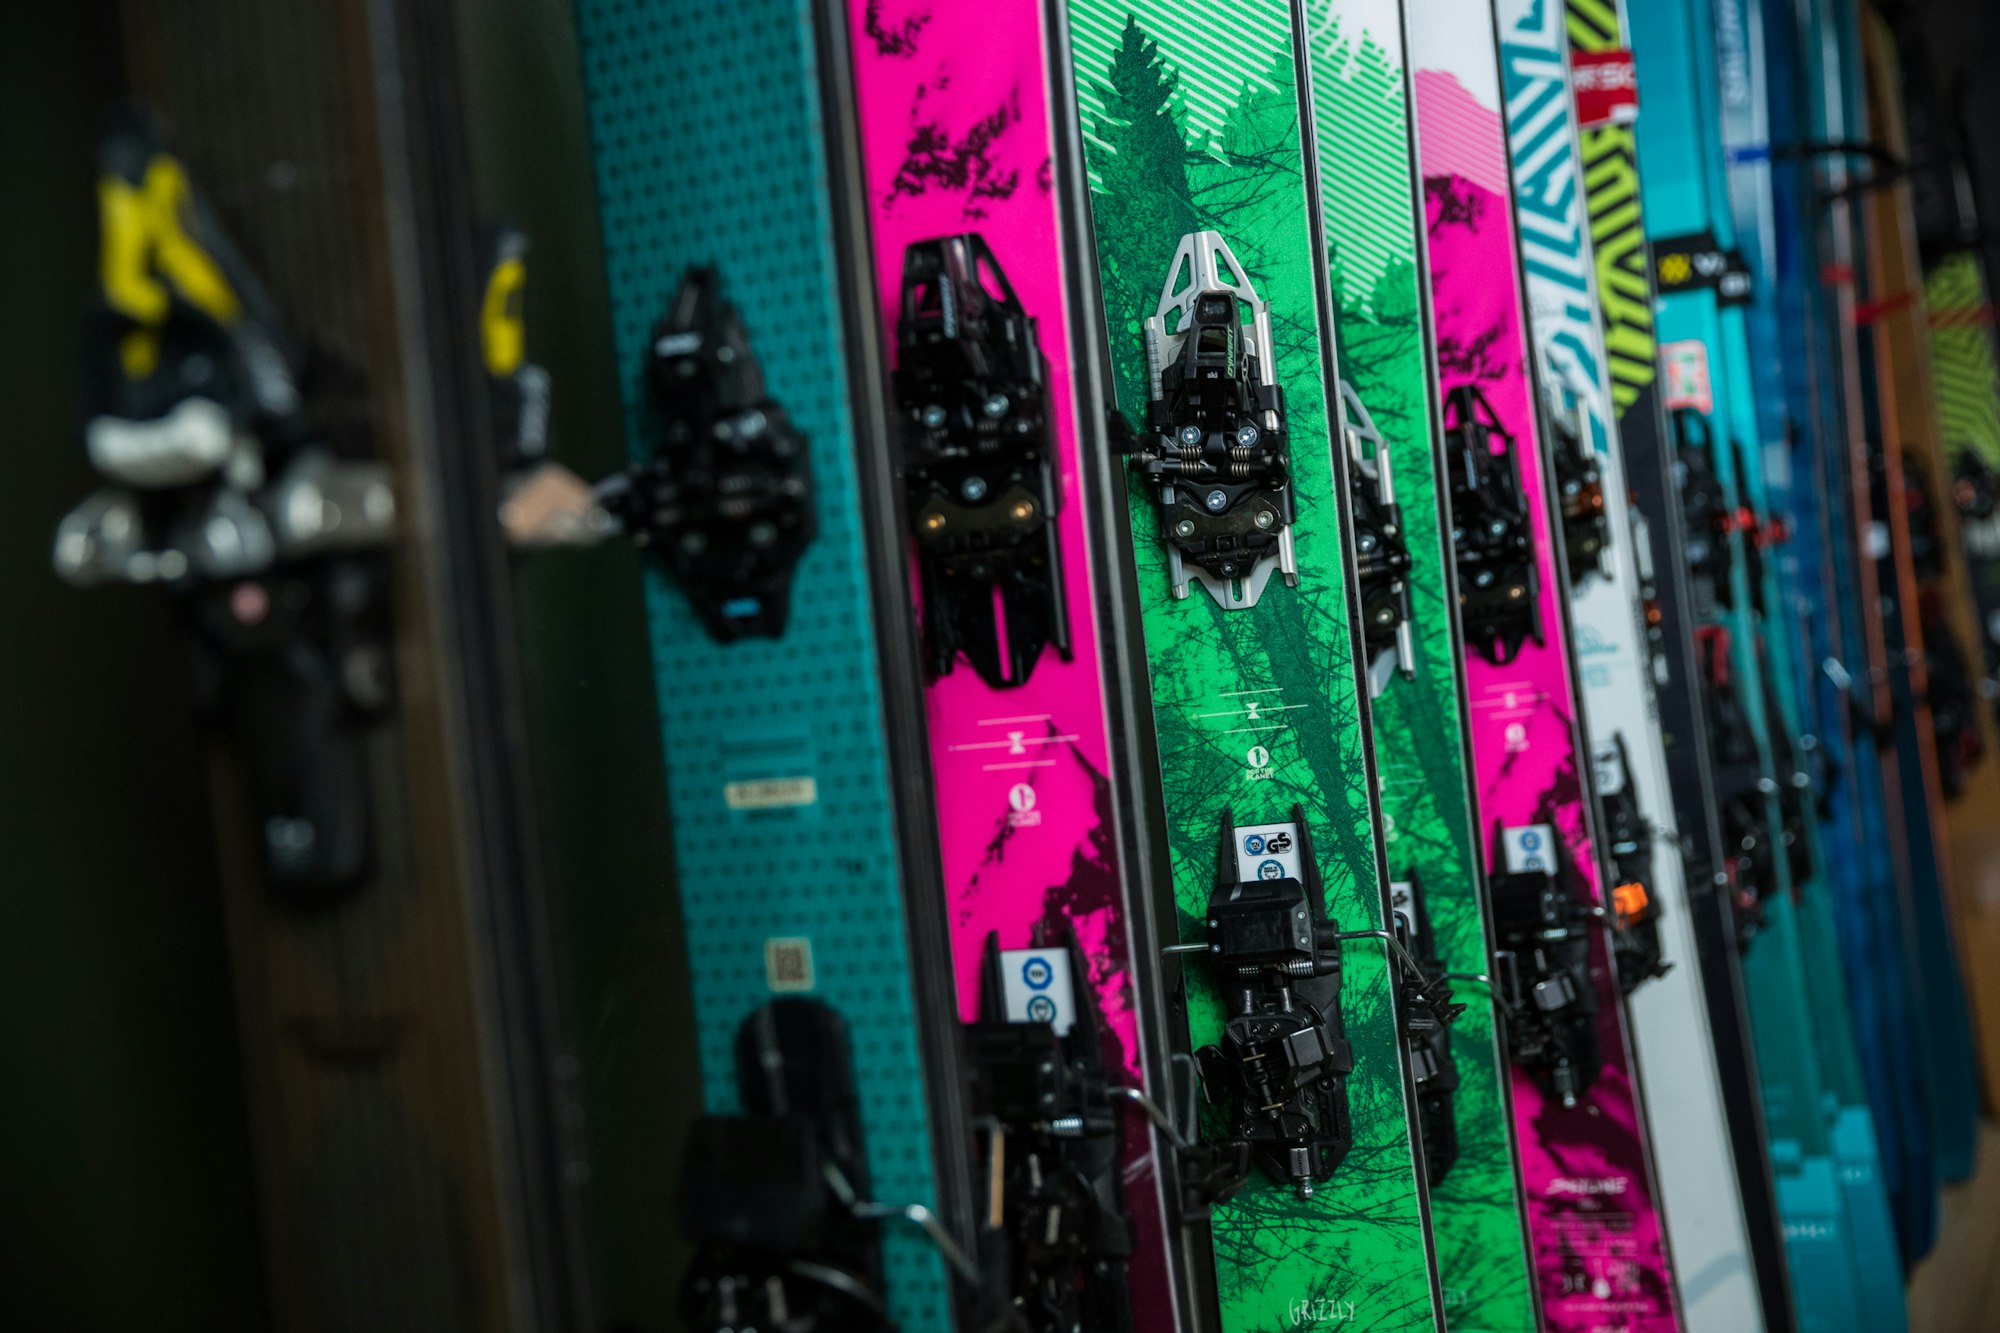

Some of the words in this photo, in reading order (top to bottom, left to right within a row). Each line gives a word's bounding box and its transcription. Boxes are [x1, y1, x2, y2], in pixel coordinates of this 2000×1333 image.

[1206, 371, 1218, 379] ski
[1267, 832, 1292, 854] GS
[1288, 1297, 1355, 1326] GRIZZLY
